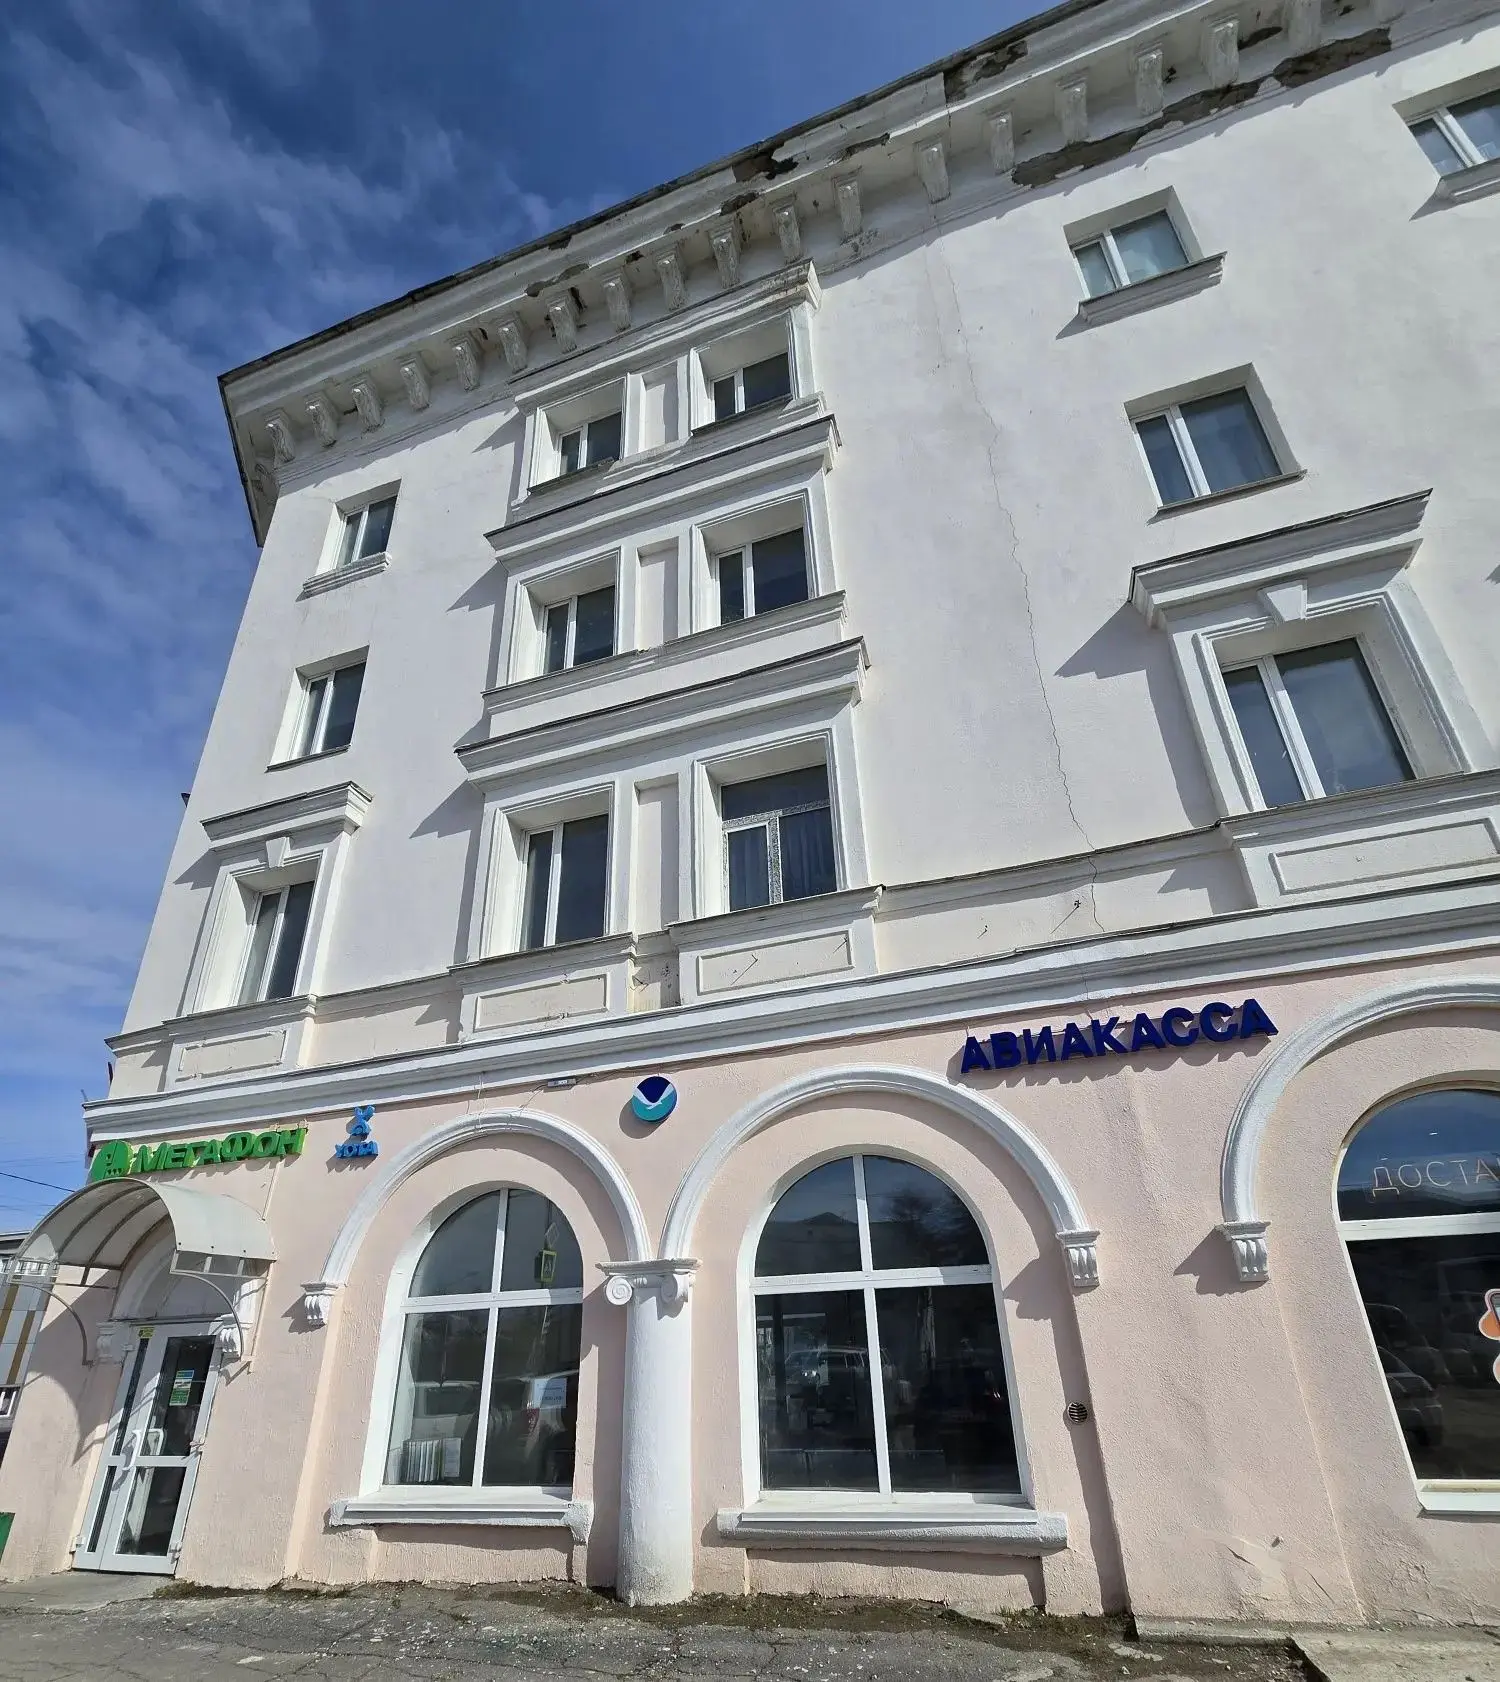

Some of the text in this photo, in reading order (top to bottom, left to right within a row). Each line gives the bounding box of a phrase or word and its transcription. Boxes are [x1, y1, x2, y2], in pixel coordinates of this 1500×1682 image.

[960, 998, 1278, 1074] АВИАКАССА
[131, 1128, 308, 1173] МЕГАФОН
[1372, 1158, 1500, 1198] ДОСТА
